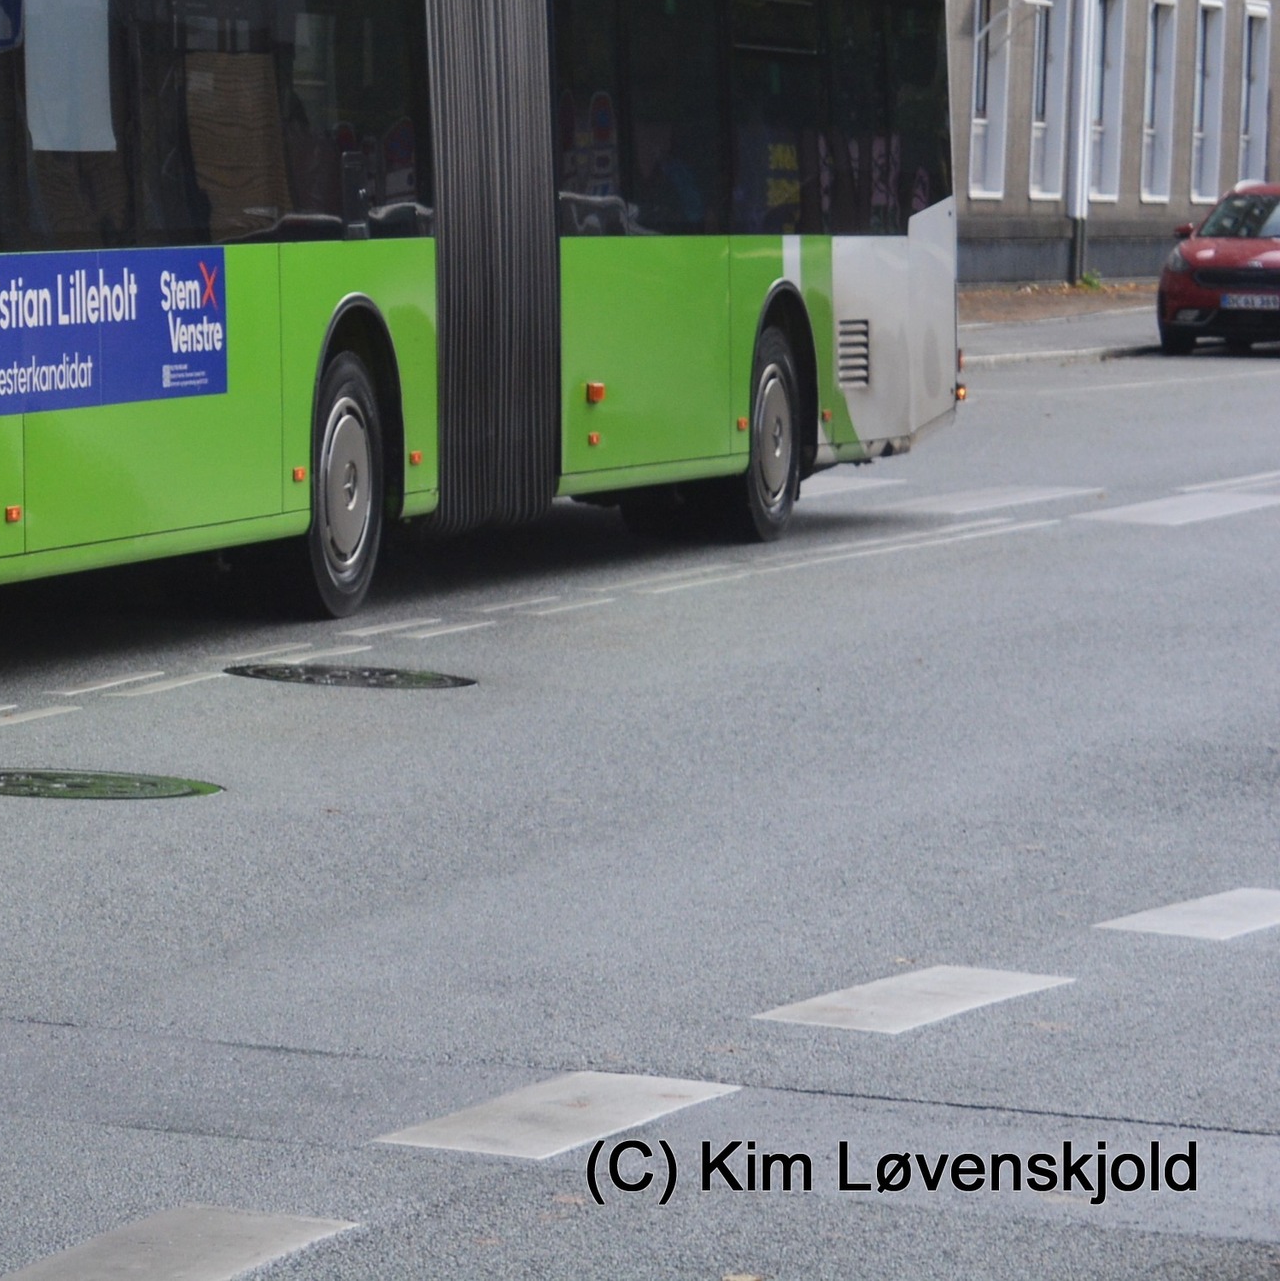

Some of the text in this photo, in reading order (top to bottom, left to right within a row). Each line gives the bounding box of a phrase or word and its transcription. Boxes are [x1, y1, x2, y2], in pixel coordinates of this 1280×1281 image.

[57, 267, 138, 326] Lilleholt
[160, 270, 201, 312] Stem
[168, 310, 223, 354] Venstre
